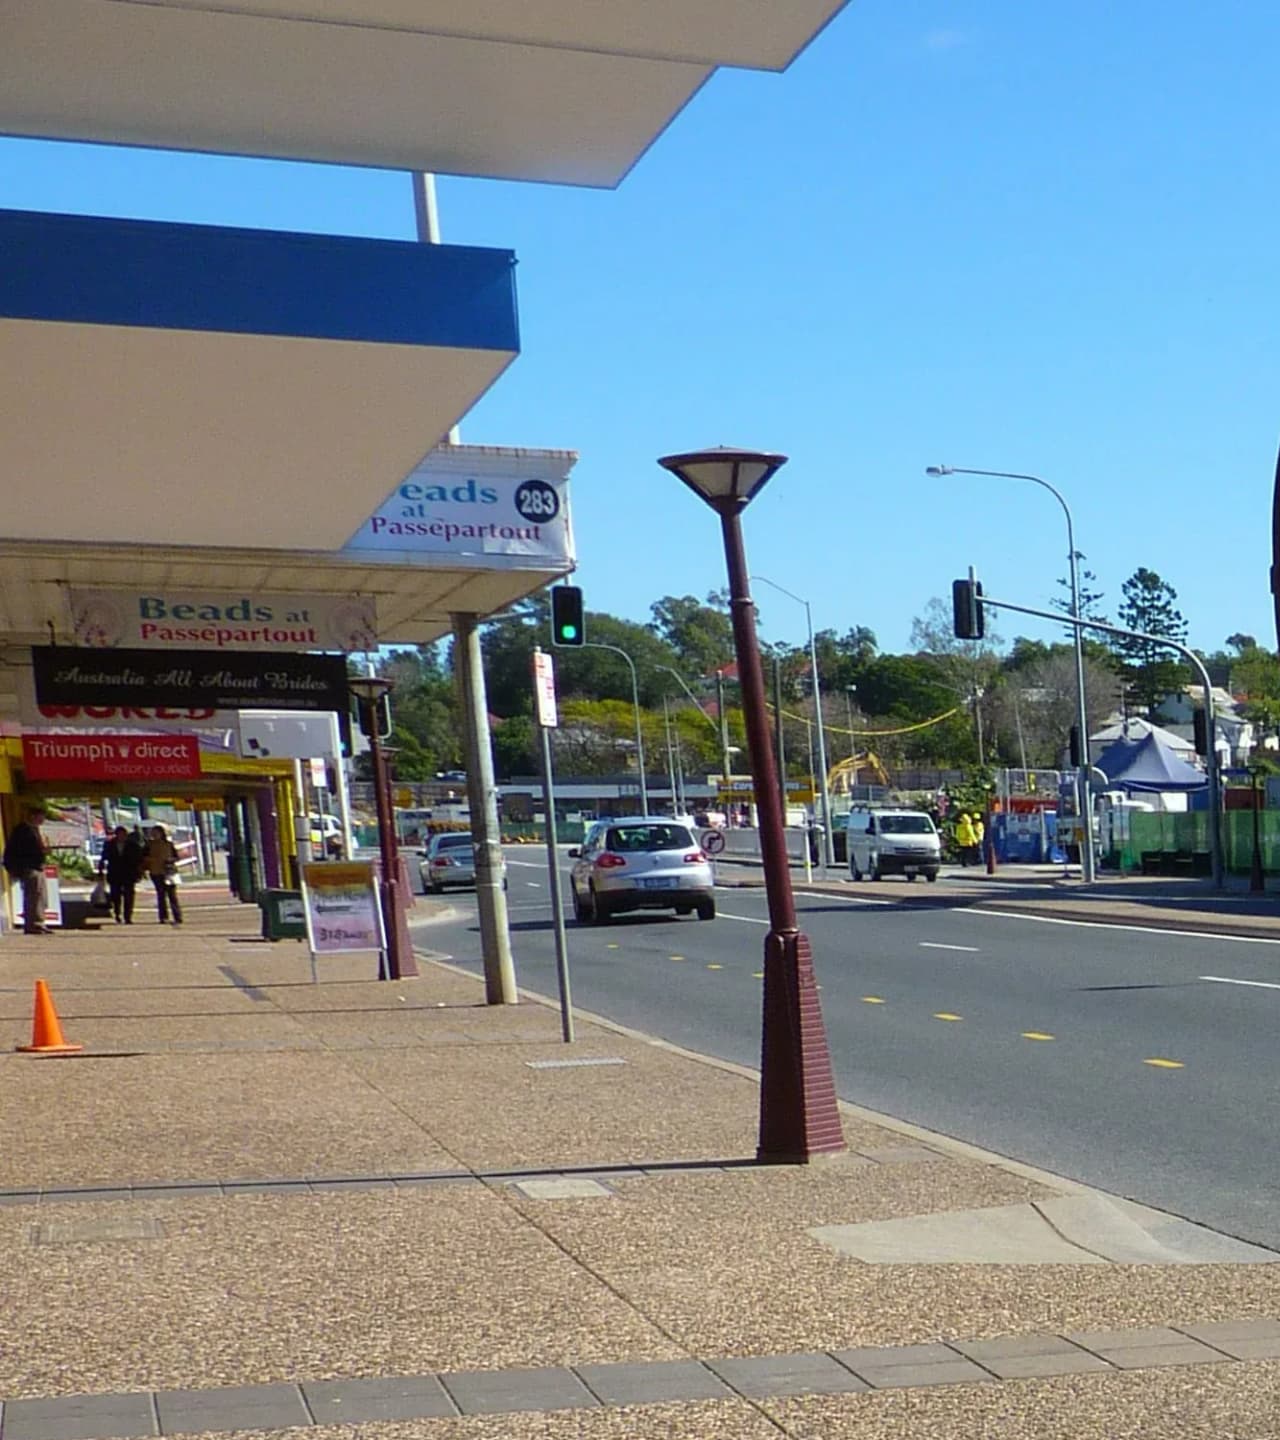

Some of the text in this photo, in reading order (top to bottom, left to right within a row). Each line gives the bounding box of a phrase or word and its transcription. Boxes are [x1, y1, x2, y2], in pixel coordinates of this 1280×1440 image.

[399, 479, 499, 504] eads
[519, 490, 555, 515] 283
[402, 503, 425, 518] at
[139, 598, 310, 623] Beads at
[53, 666, 329, 691] Australia All About Brides
[29, 740, 188, 765] Triumph direct
[104, 762, 151, 777] factory
